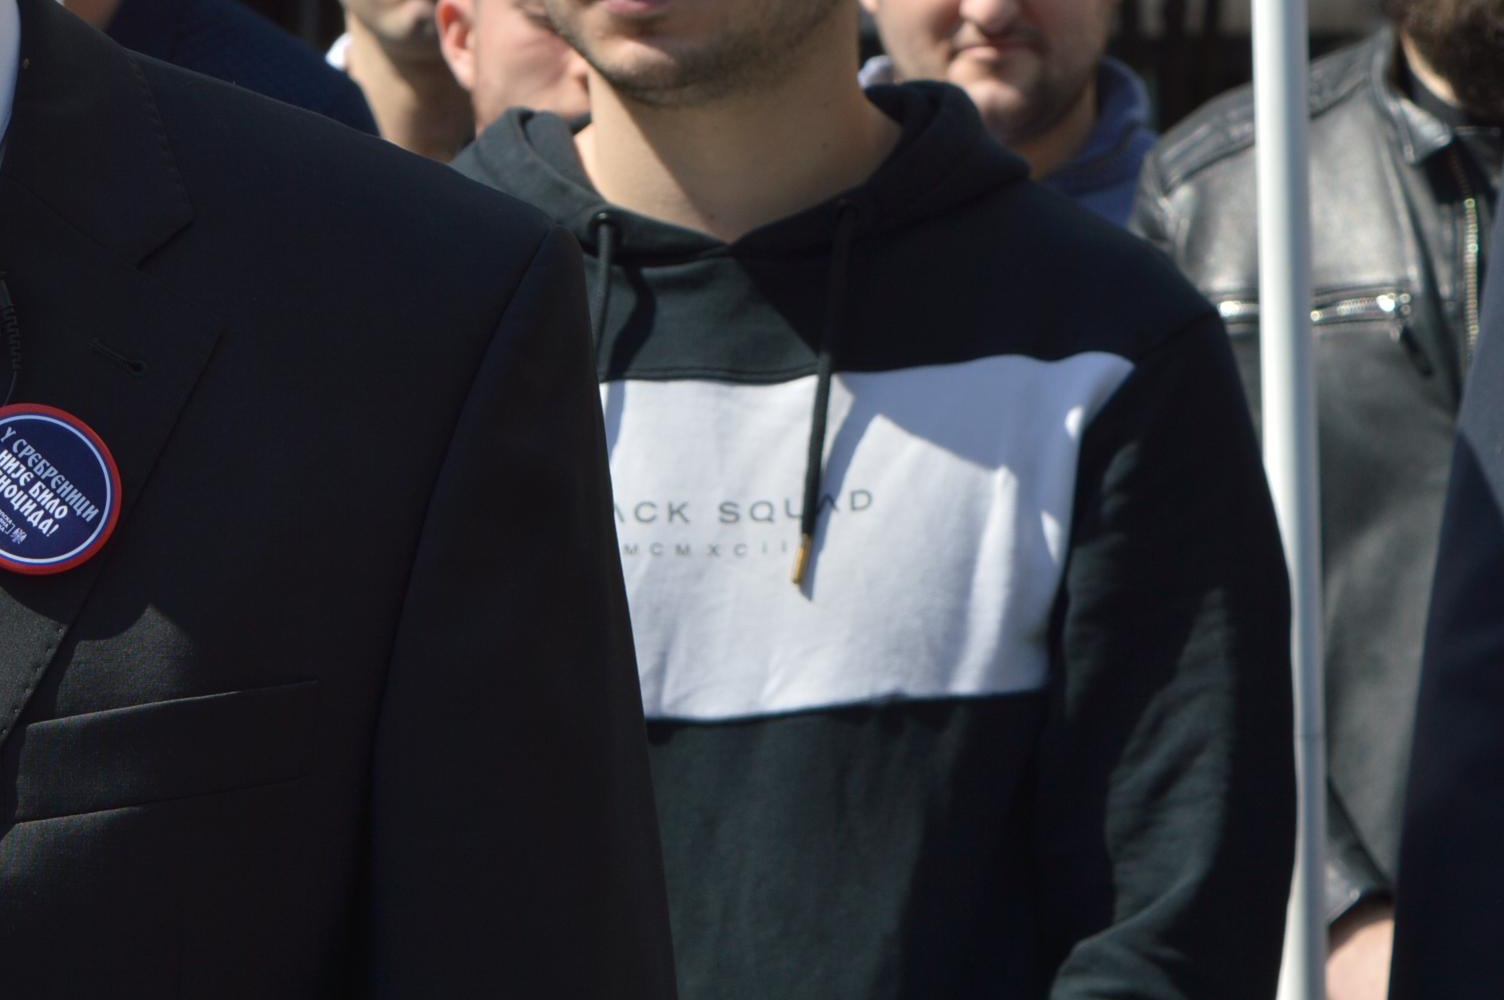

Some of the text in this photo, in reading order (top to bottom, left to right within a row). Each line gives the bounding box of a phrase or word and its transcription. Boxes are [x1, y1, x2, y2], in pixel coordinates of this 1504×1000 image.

[0, 426, 100, 524] У СРЕБРЕНИЦИ
[28, 480, 69, 520] БИЛО
[717, 488, 874, 525] SQUAD
